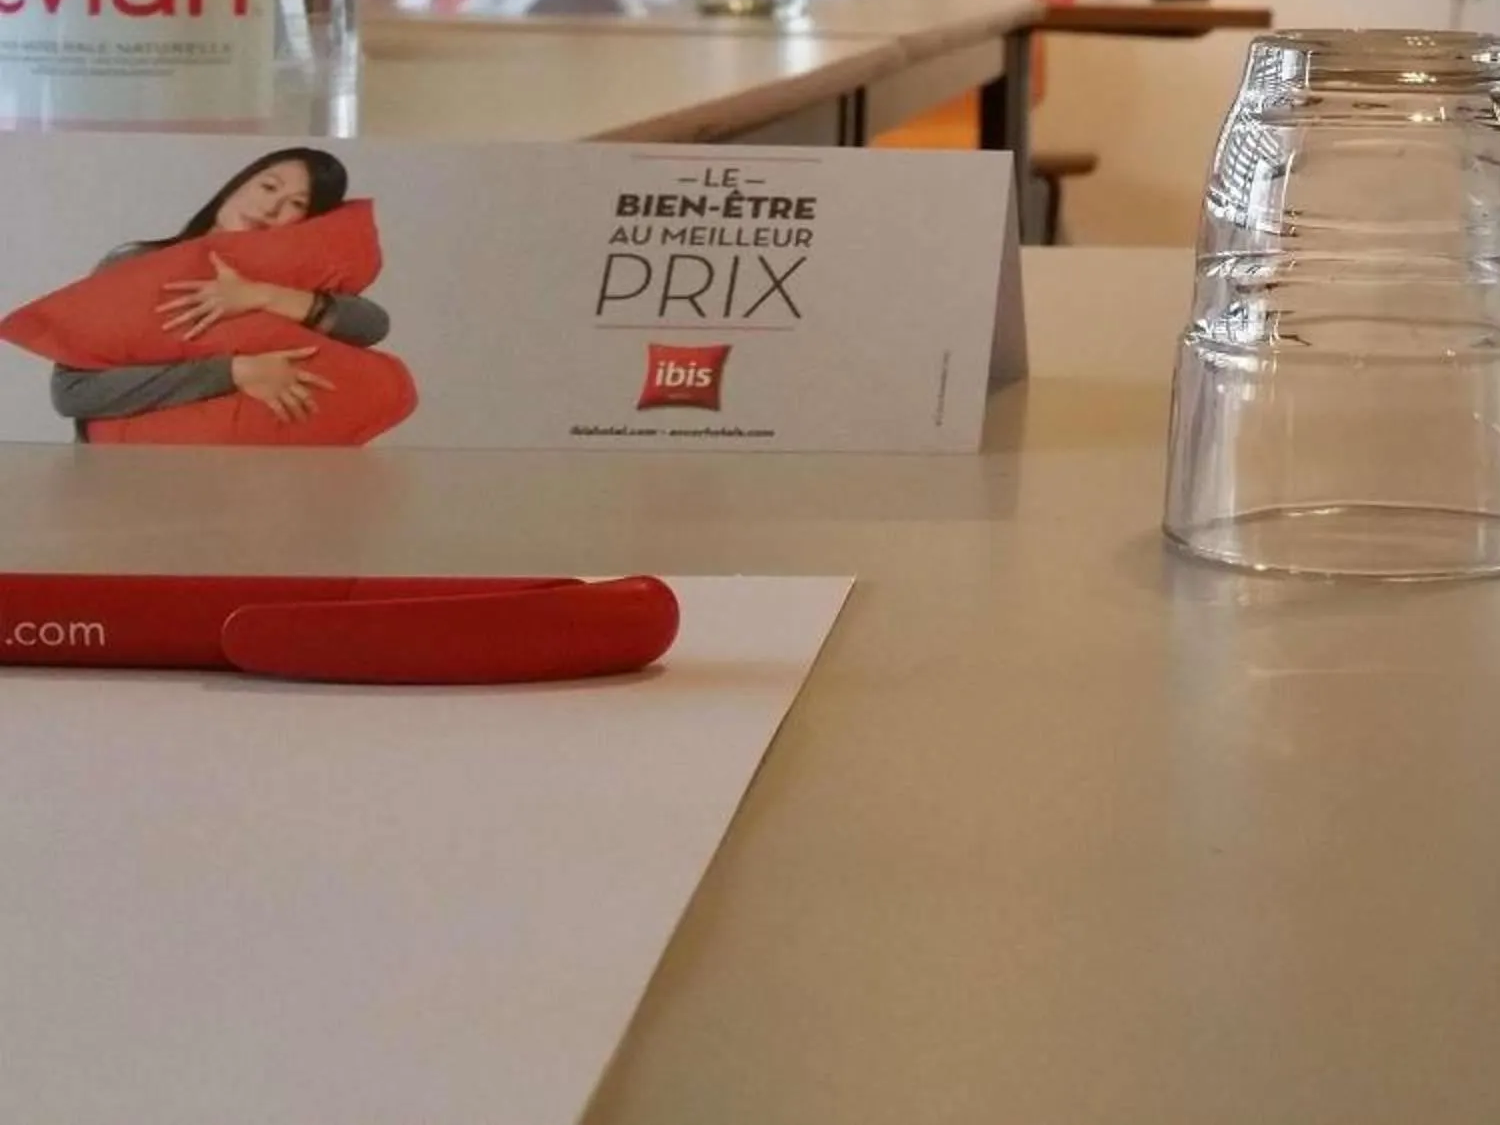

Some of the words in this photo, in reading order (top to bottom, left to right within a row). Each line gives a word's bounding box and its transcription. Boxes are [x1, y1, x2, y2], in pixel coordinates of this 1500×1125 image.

[703, 167, 741, 188] LE
[615, 188, 818, 221] BIEN-ÊTRE
[608, 225, 653, 246] AU
[660, 226, 815, 248] MEILLEUR
[595, 252, 807, 319] PRIX
[655, 360, 713, 388] ibis
